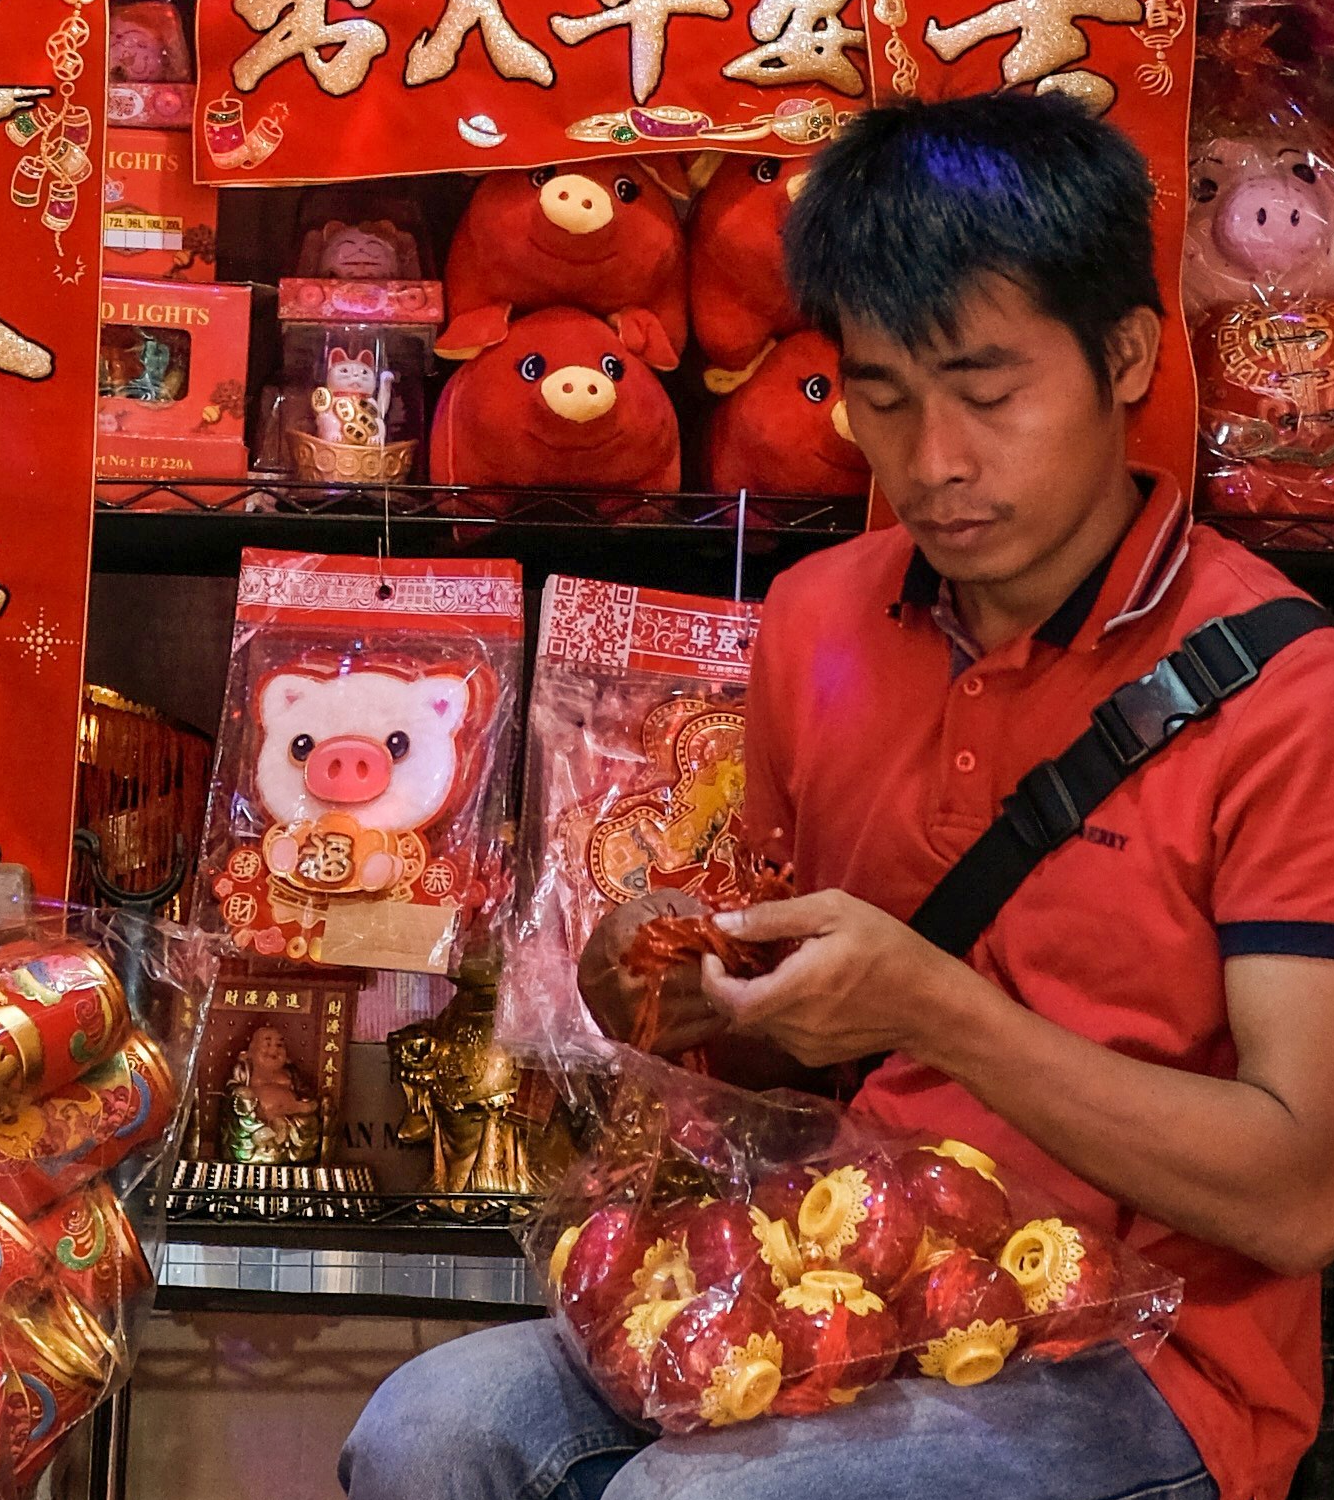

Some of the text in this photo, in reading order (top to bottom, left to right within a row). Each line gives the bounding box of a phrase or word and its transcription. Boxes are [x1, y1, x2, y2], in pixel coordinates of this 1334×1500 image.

[107, 151, 180, 172] IGHTS
[122, 302, 210, 326] LIGHTS
[422, 864, 454, 894] 恭
